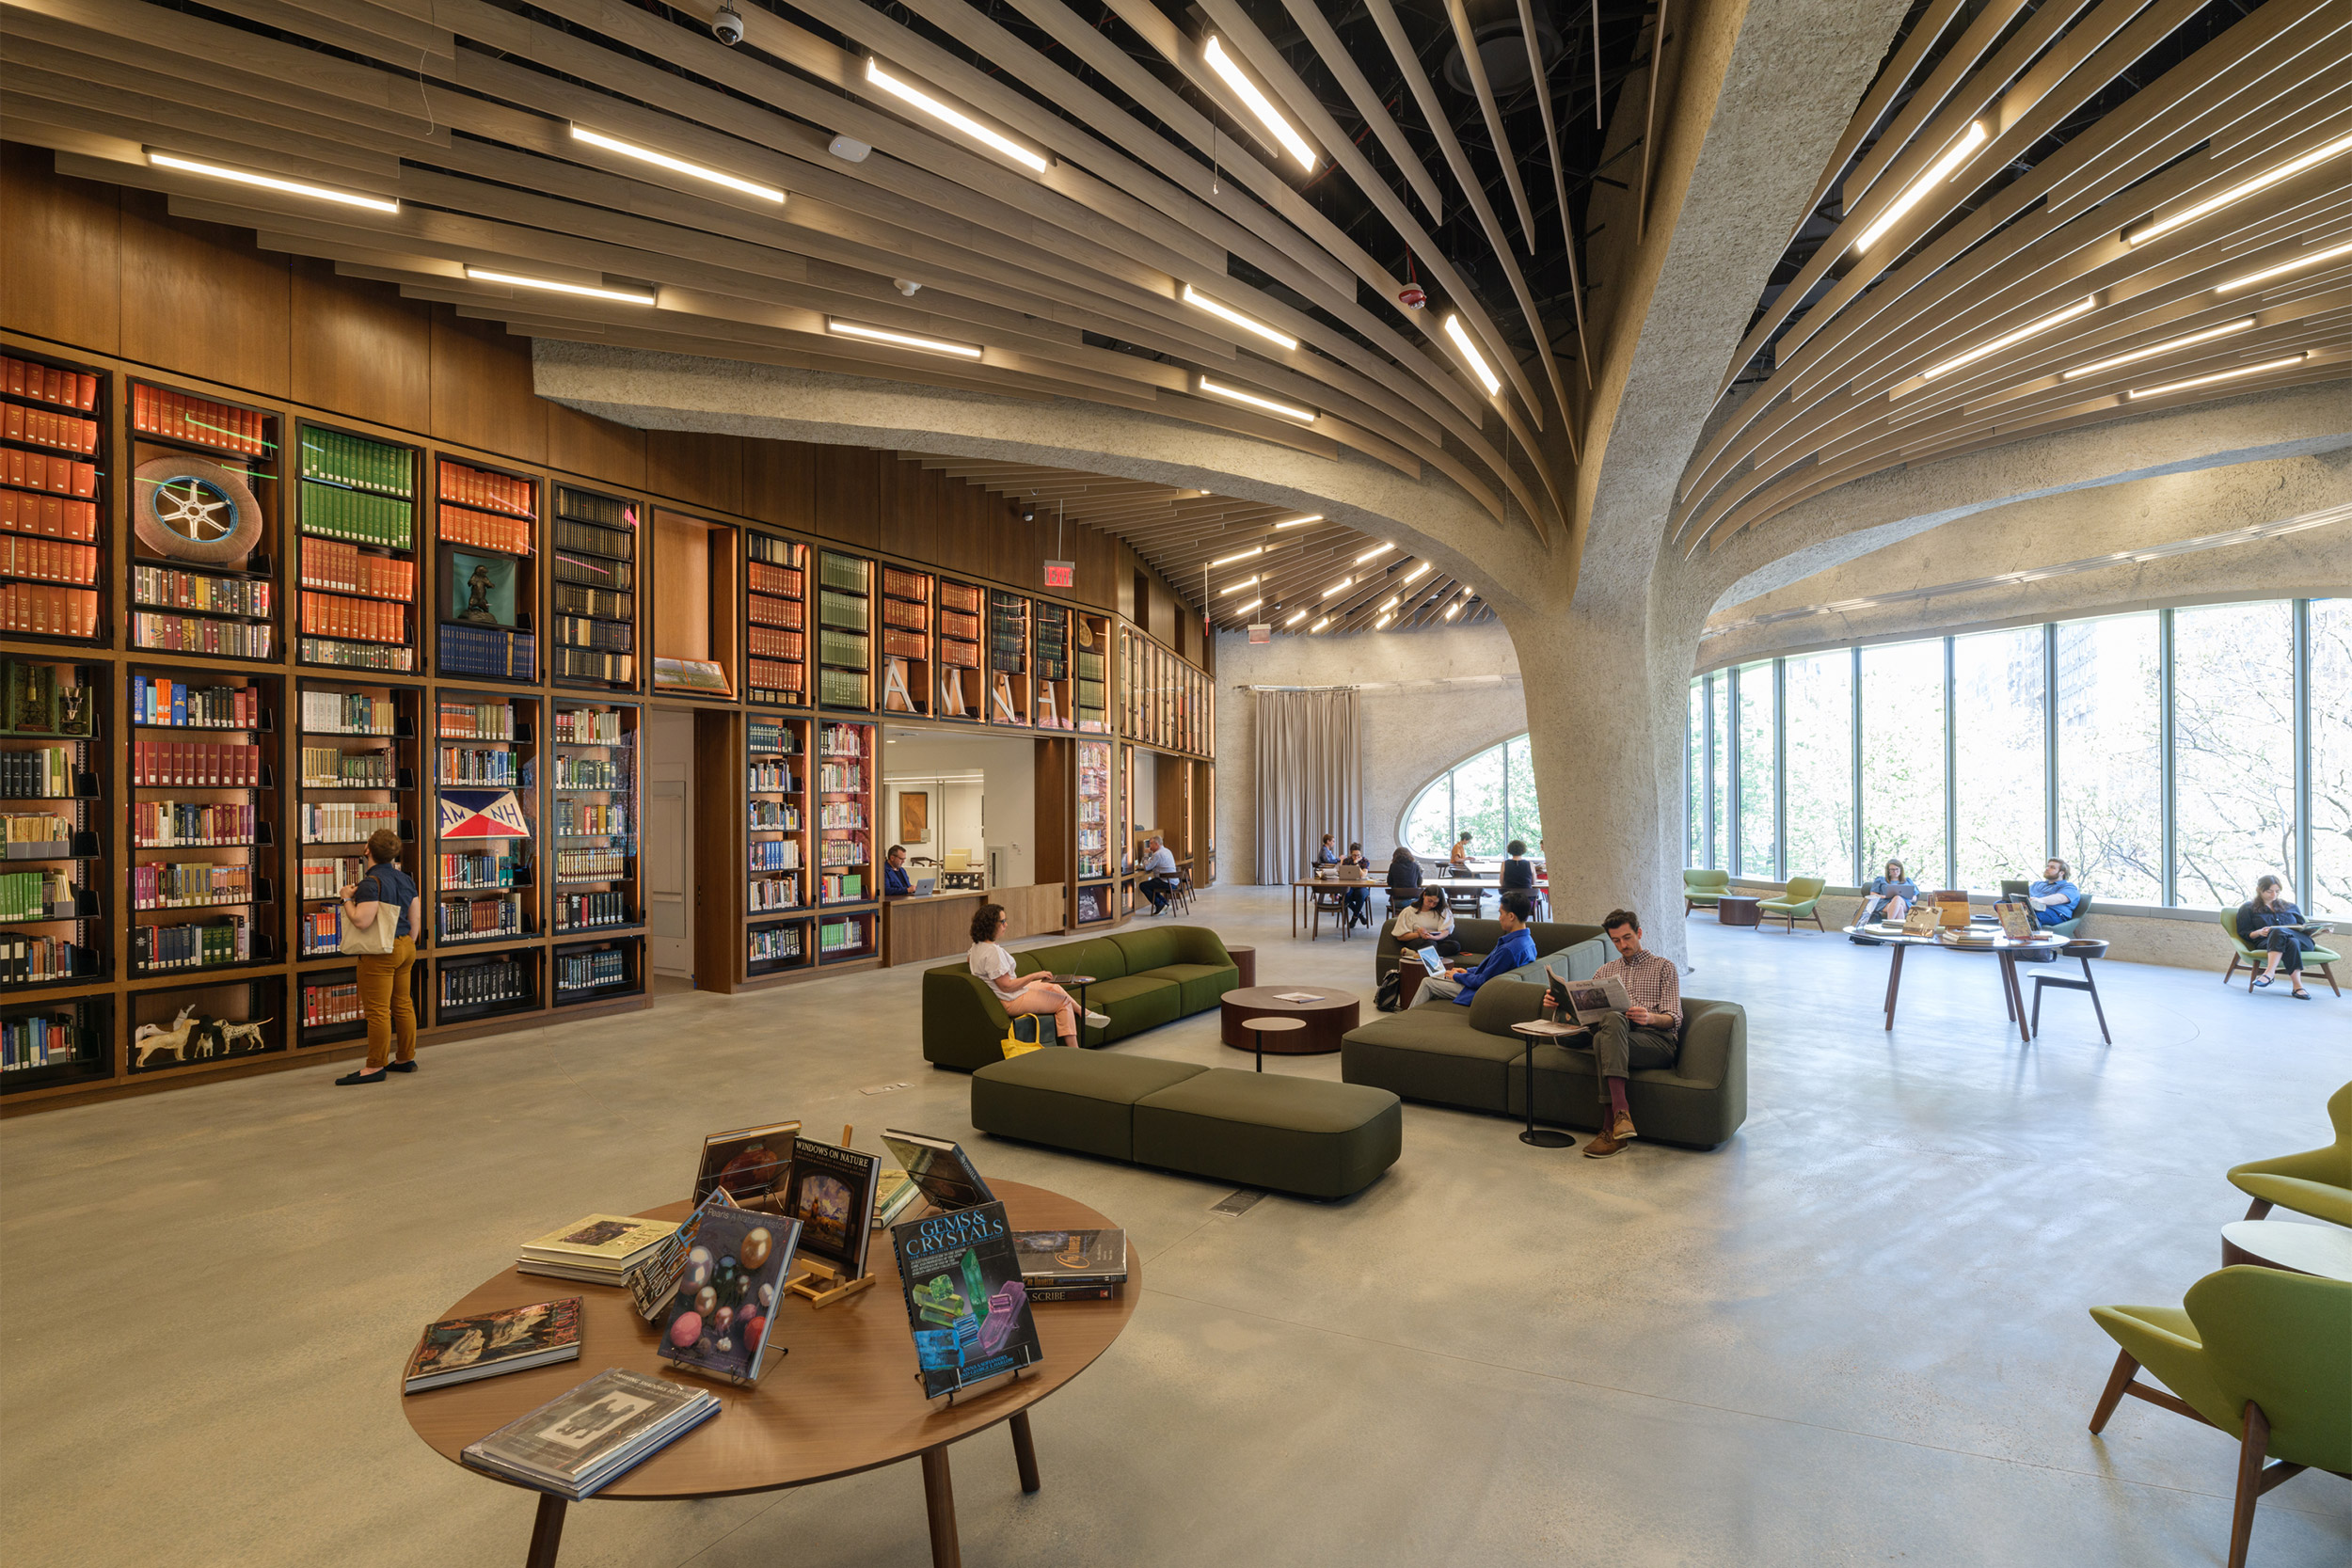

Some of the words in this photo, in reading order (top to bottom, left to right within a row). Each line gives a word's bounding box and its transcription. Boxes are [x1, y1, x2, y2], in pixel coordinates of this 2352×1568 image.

[1048, 566, 1072, 584] EXIT
[490, 803, 521, 828] NH
[796, 1140, 829, 1157] WINDOWS
[829, 1149, 839, 1160] ON
[840, 1152, 869, 1167] NATURE
[707, 1207, 730, 1219] Pearls
[737, 1214, 762, 1226] Natural
[764, 1217, 790, 1232] History
[920, 1212, 971, 1237] GEMS
[973, 1210, 988, 1225] &
[906, 1219, 1004, 1256] CRYSTALS
[1032, 1291, 1066, 1301] SCRIBE
